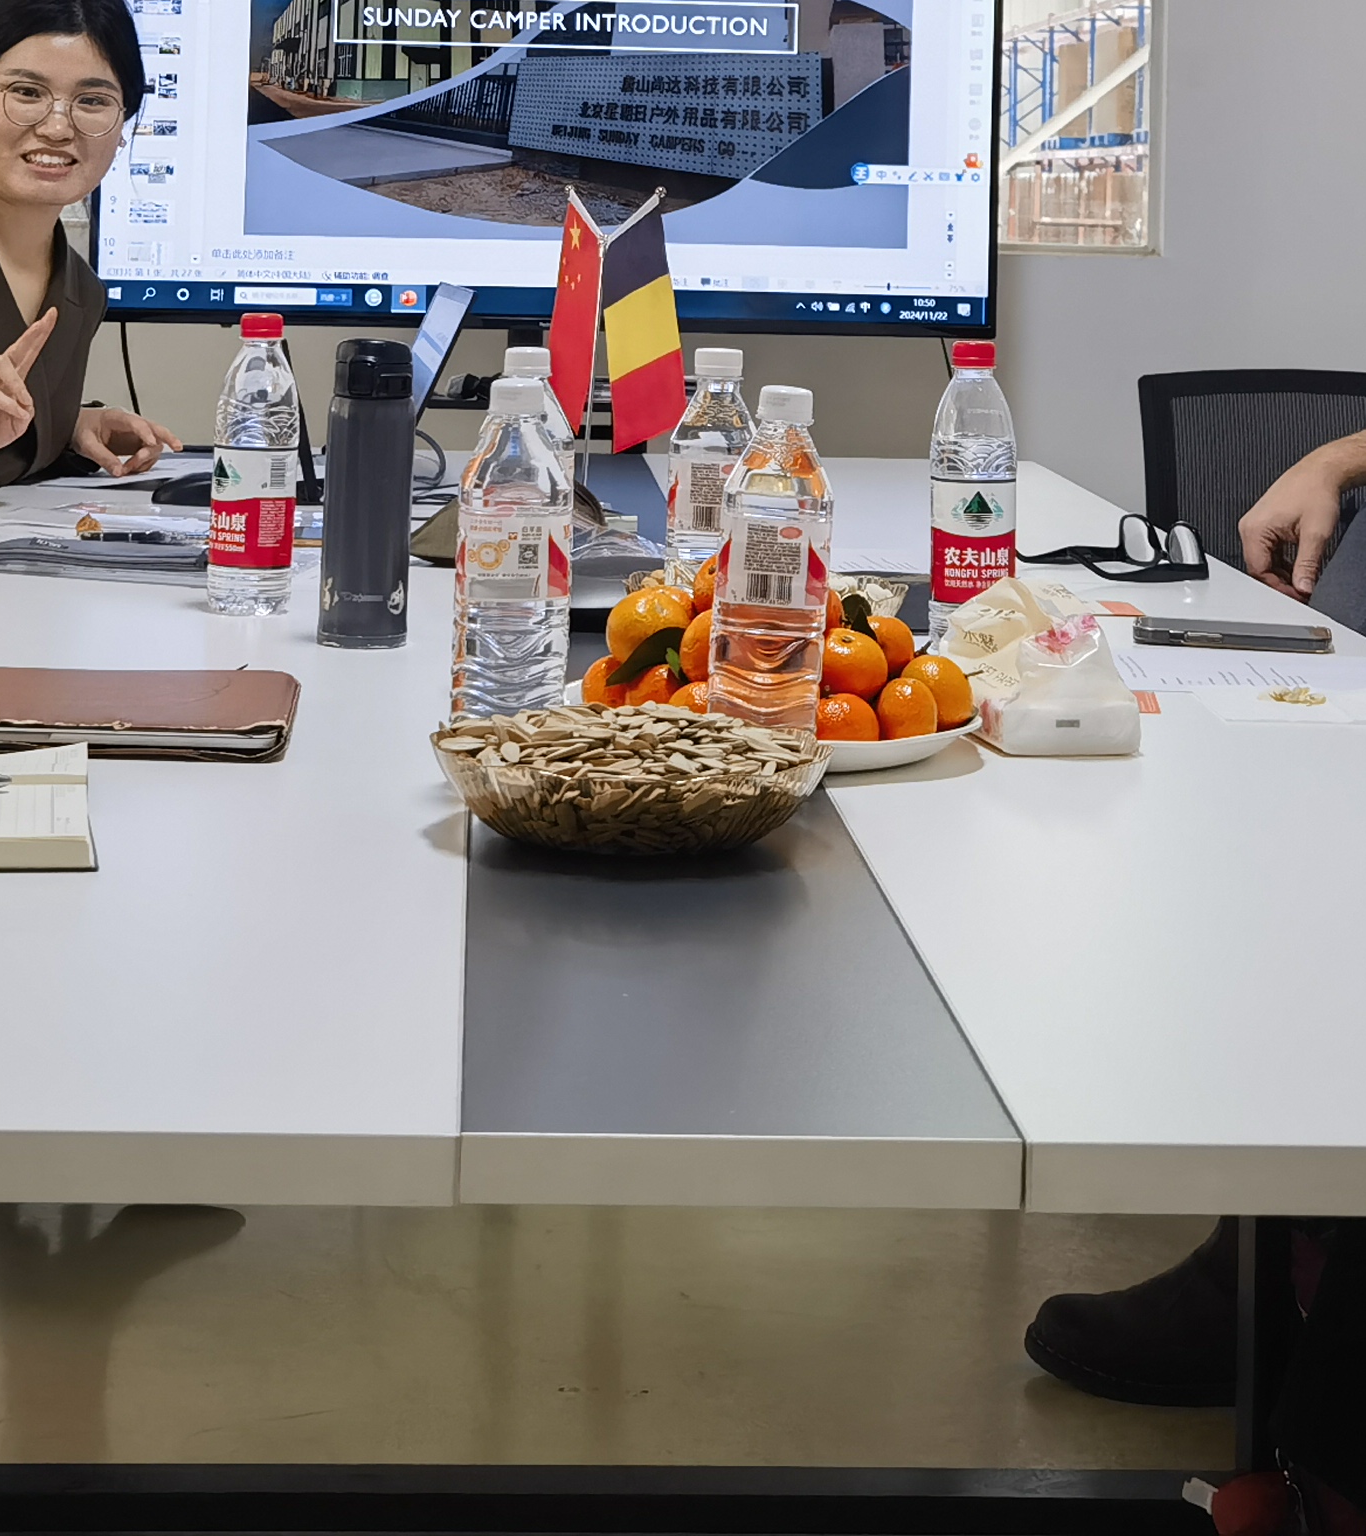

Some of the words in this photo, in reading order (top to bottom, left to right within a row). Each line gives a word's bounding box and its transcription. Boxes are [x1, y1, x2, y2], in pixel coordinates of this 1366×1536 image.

[362, 5, 462, 31] SUNDAY
[469, 9, 567, 33] CAMPER
[574, 12, 769, 37] INTRODUCTION
[598, 128, 640, 148] SUNDAY
[650, 133, 706, 154] CAMPERS
[913, 298, 936, 308] 10:50
[899, 310, 948, 322] 2024/11/22
[218, 531, 246, 543] SPRING
[944, 546, 1010, 567] 农夫山泉
[944, 567, 979, 579] NONGFU
[981, 568, 1009, 579] SPRING
